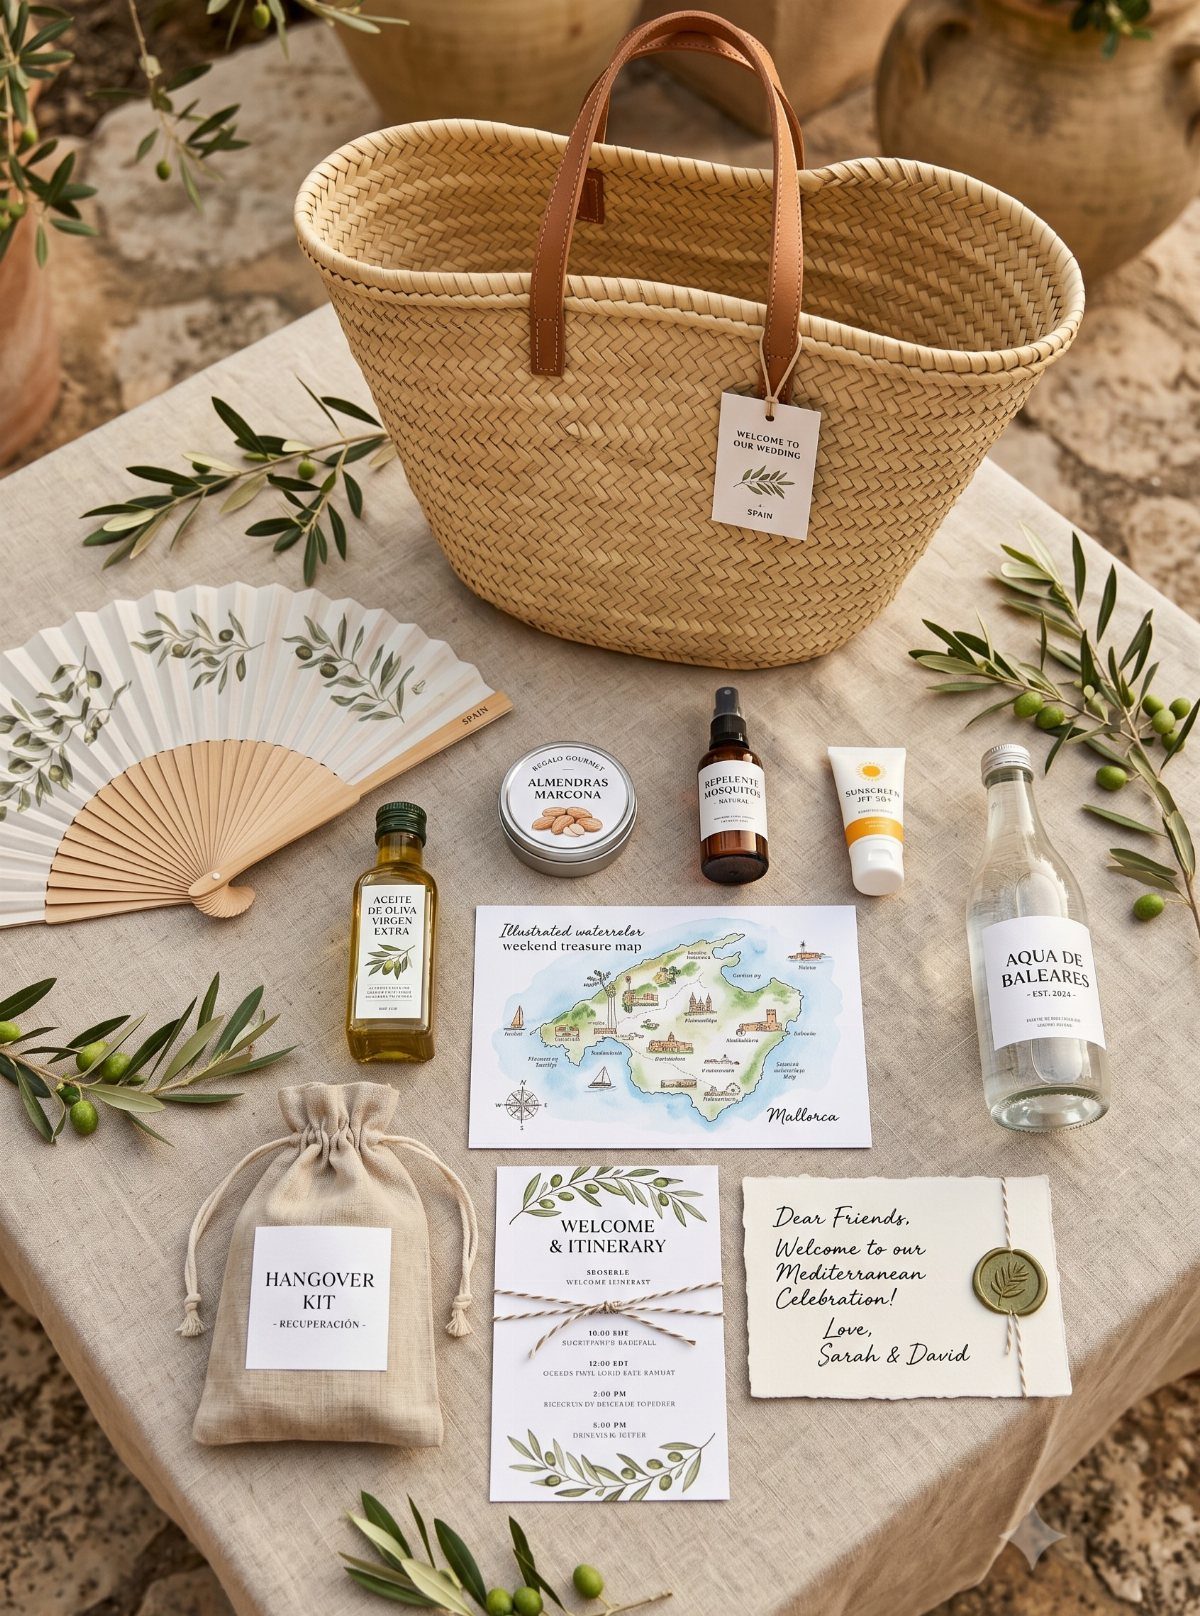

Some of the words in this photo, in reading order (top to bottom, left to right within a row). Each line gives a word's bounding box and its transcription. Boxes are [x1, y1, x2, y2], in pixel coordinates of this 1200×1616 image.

[737, 430, 784, 445] WELCOME
[787, 440, 800, 449] TO
[733, 440, 754, 450] OUR
[756, 444, 801, 460] WEDDING
[747, 509, 773, 520] SPAIN
[462, 706, 489, 725] SPAIN
[532, 755, 563, 772] REGALO
[565, 755, 605, 772] GOURMET
[528, 778, 609, 787] ALMENDRAS
[704, 776, 759, 789] REPELENTE
[534, 790, 602, 799] MARCONA
[704, 785, 761, 800] MOSQUITOS
[373, 896, 412, 904] ACEITE
[368, 907, 382, 915] DE
[385, 907, 417, 915] OLIVA
[372, 917, 413, 925] VIRGEN
[374, 927, 409, 935] EXTRA
[499, 923, 572, 939] Illustrated
[502, 940, 557, 951] weekend
[561, 942, 612, 951] treasure
[615, 943, 642, 954] map
[1006, 949, 1058, 967] AQUA
[1062, 950, 1084, 968] DE
[1002, 968, 1090, 988] BALEARES
[766, 1107, 841, 1125] Mallorca
[772, 1206, 826, 1228] Dear
[832, 1205, 910, 1228] Friends,
[561, 1219, 655, 1233] WELCOME
[549, 1239, 563, 1253] &
[568, 1239, 666, 1253] ITINERARY
[775, 1236, 861, 1257] Welcome
[866, 1239, 887, 1256] to
[892, 1245, 927, 1256] our
[265, 1271, 375, 1288] HANGOVER
[776, 1262, 927, 1285] Mediterranean
[303, 1294, 336, 1310] KIT
[775, 1287, 898, 1310] Celebration!
[279, 1318, 360, 1329] RECUPERACIÓN
[822, 1317, 873, 1340] Love,
[817, 1342, 881, 1367] Sarah
[886, 1346, 901, 1363] &
[906, 1342, 971, 1366] David
